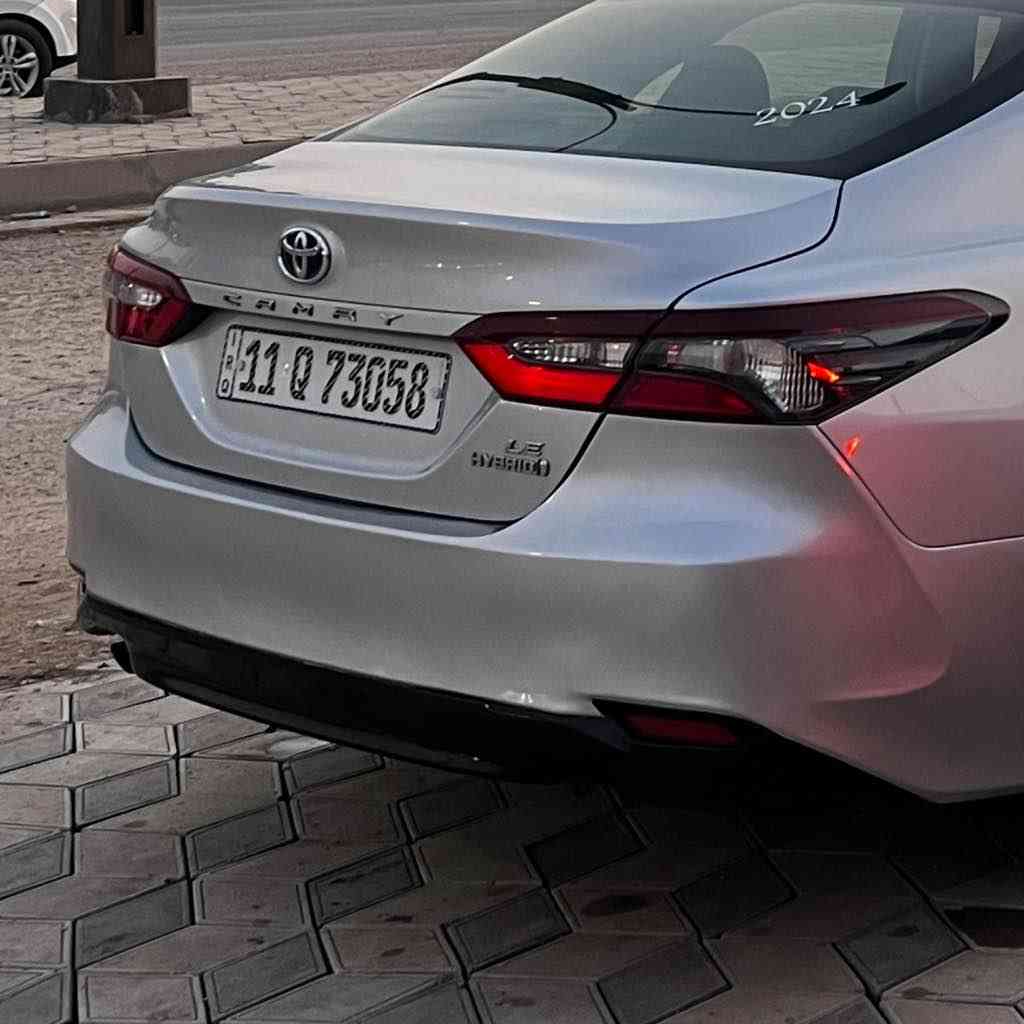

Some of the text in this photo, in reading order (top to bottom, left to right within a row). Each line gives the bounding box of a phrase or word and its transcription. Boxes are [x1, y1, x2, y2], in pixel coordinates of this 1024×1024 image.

[753, 90, 861, 128] 2024
[222, 293, 406, 327] CAMRY
[239, 339, 430, 420] 11 Q 73058
[471, 451, 540, 476] HYBRID
[503, 438, 546, 458] LE
